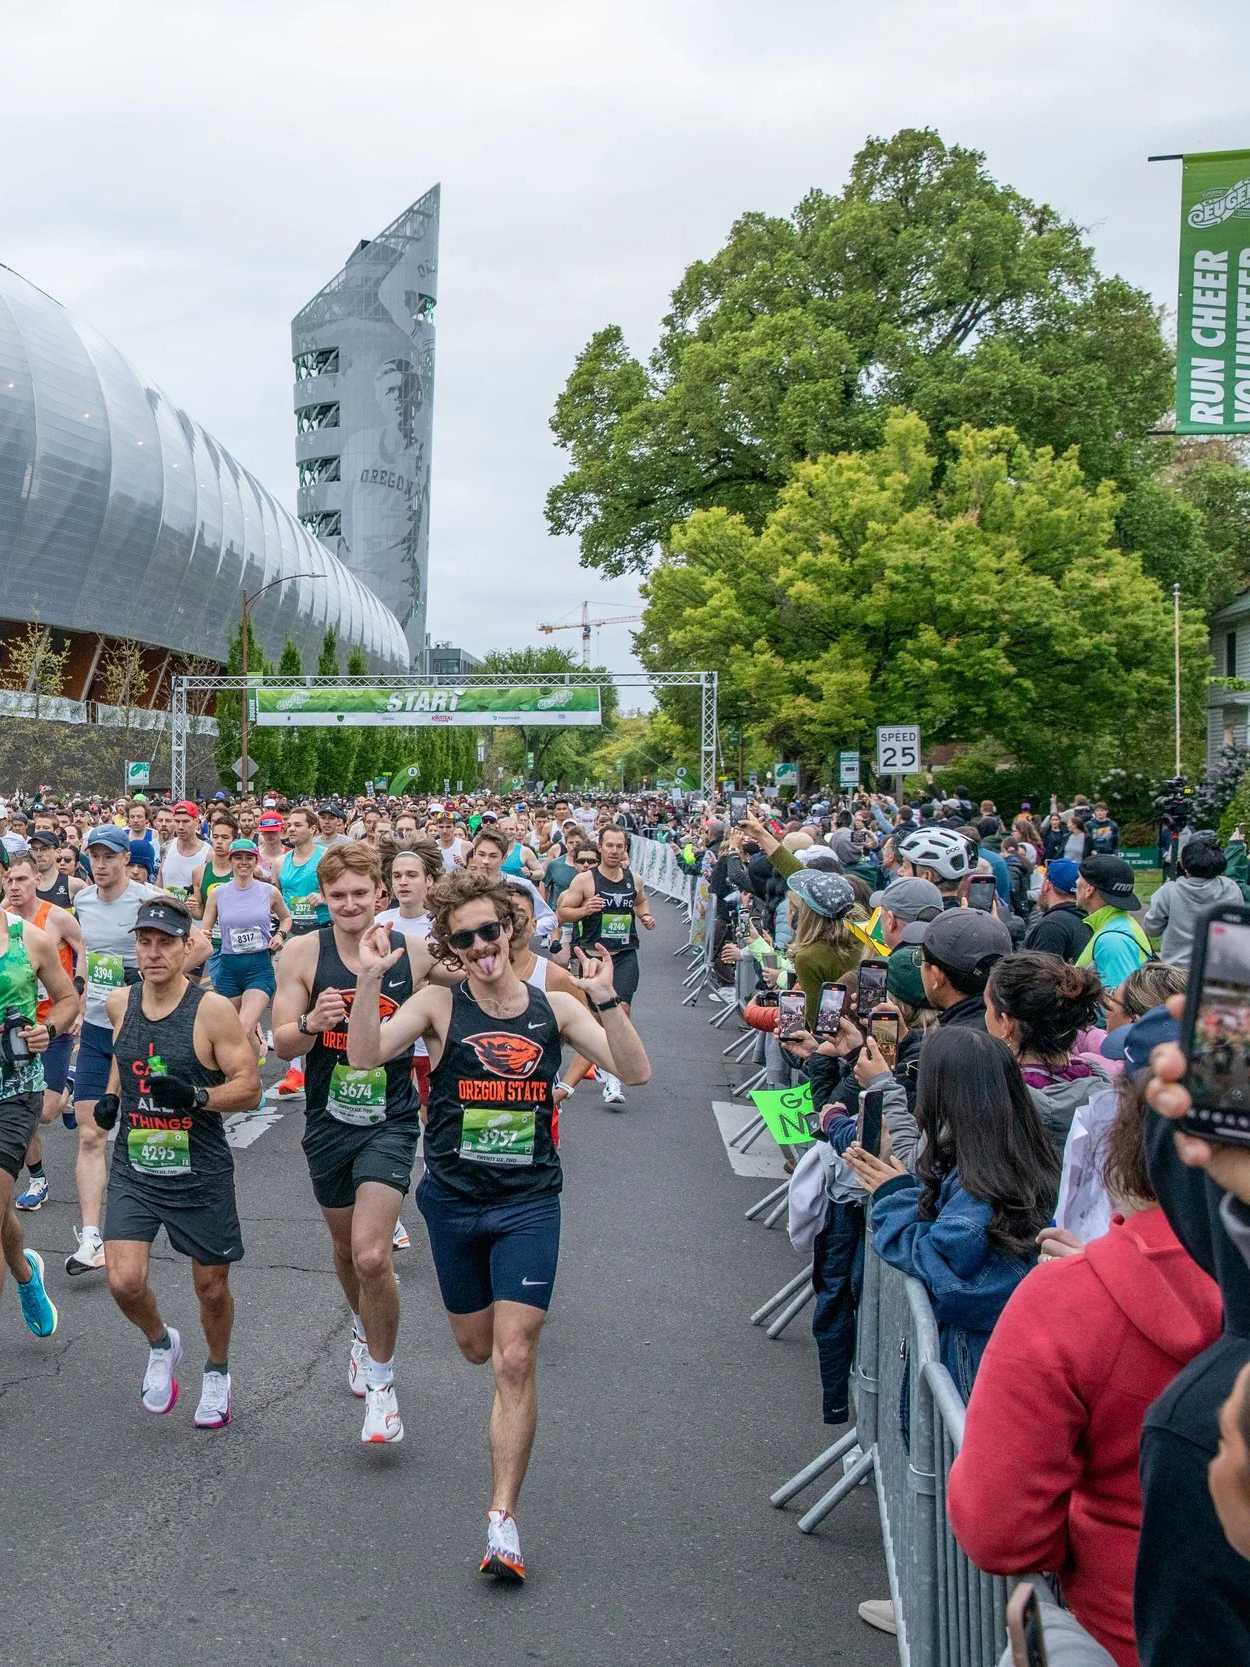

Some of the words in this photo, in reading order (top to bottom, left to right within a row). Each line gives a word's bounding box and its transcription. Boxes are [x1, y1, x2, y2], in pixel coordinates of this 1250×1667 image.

[1191, 249, 1229, 348] CHEER
[1190, 358, 1225, 424] RUN
[360, 469, 414, 497] OREGON
[387, 691, 459, 712] START
[880, 732, 916, 742] SPEED
[882, 746, 916, 767] 25
[608, 922, 625, 931] 4246
[237, 933, 255, 944] 8317
[93, 965, 113, 981] 3394
[339, 1081, 373, 1099] 3674
[458, 1080, 506, 1101] OREGON
[507, 1081, 547, 1101] STATE
[137, 1097, 174, 1113] AL
[129, 1112, 193, 1130] THINGS
[478, 1129, 519, 1147] 3957
[141, 1145, 176, 1160] 4295
[476, 1154, 496, 1162] TWENTY
